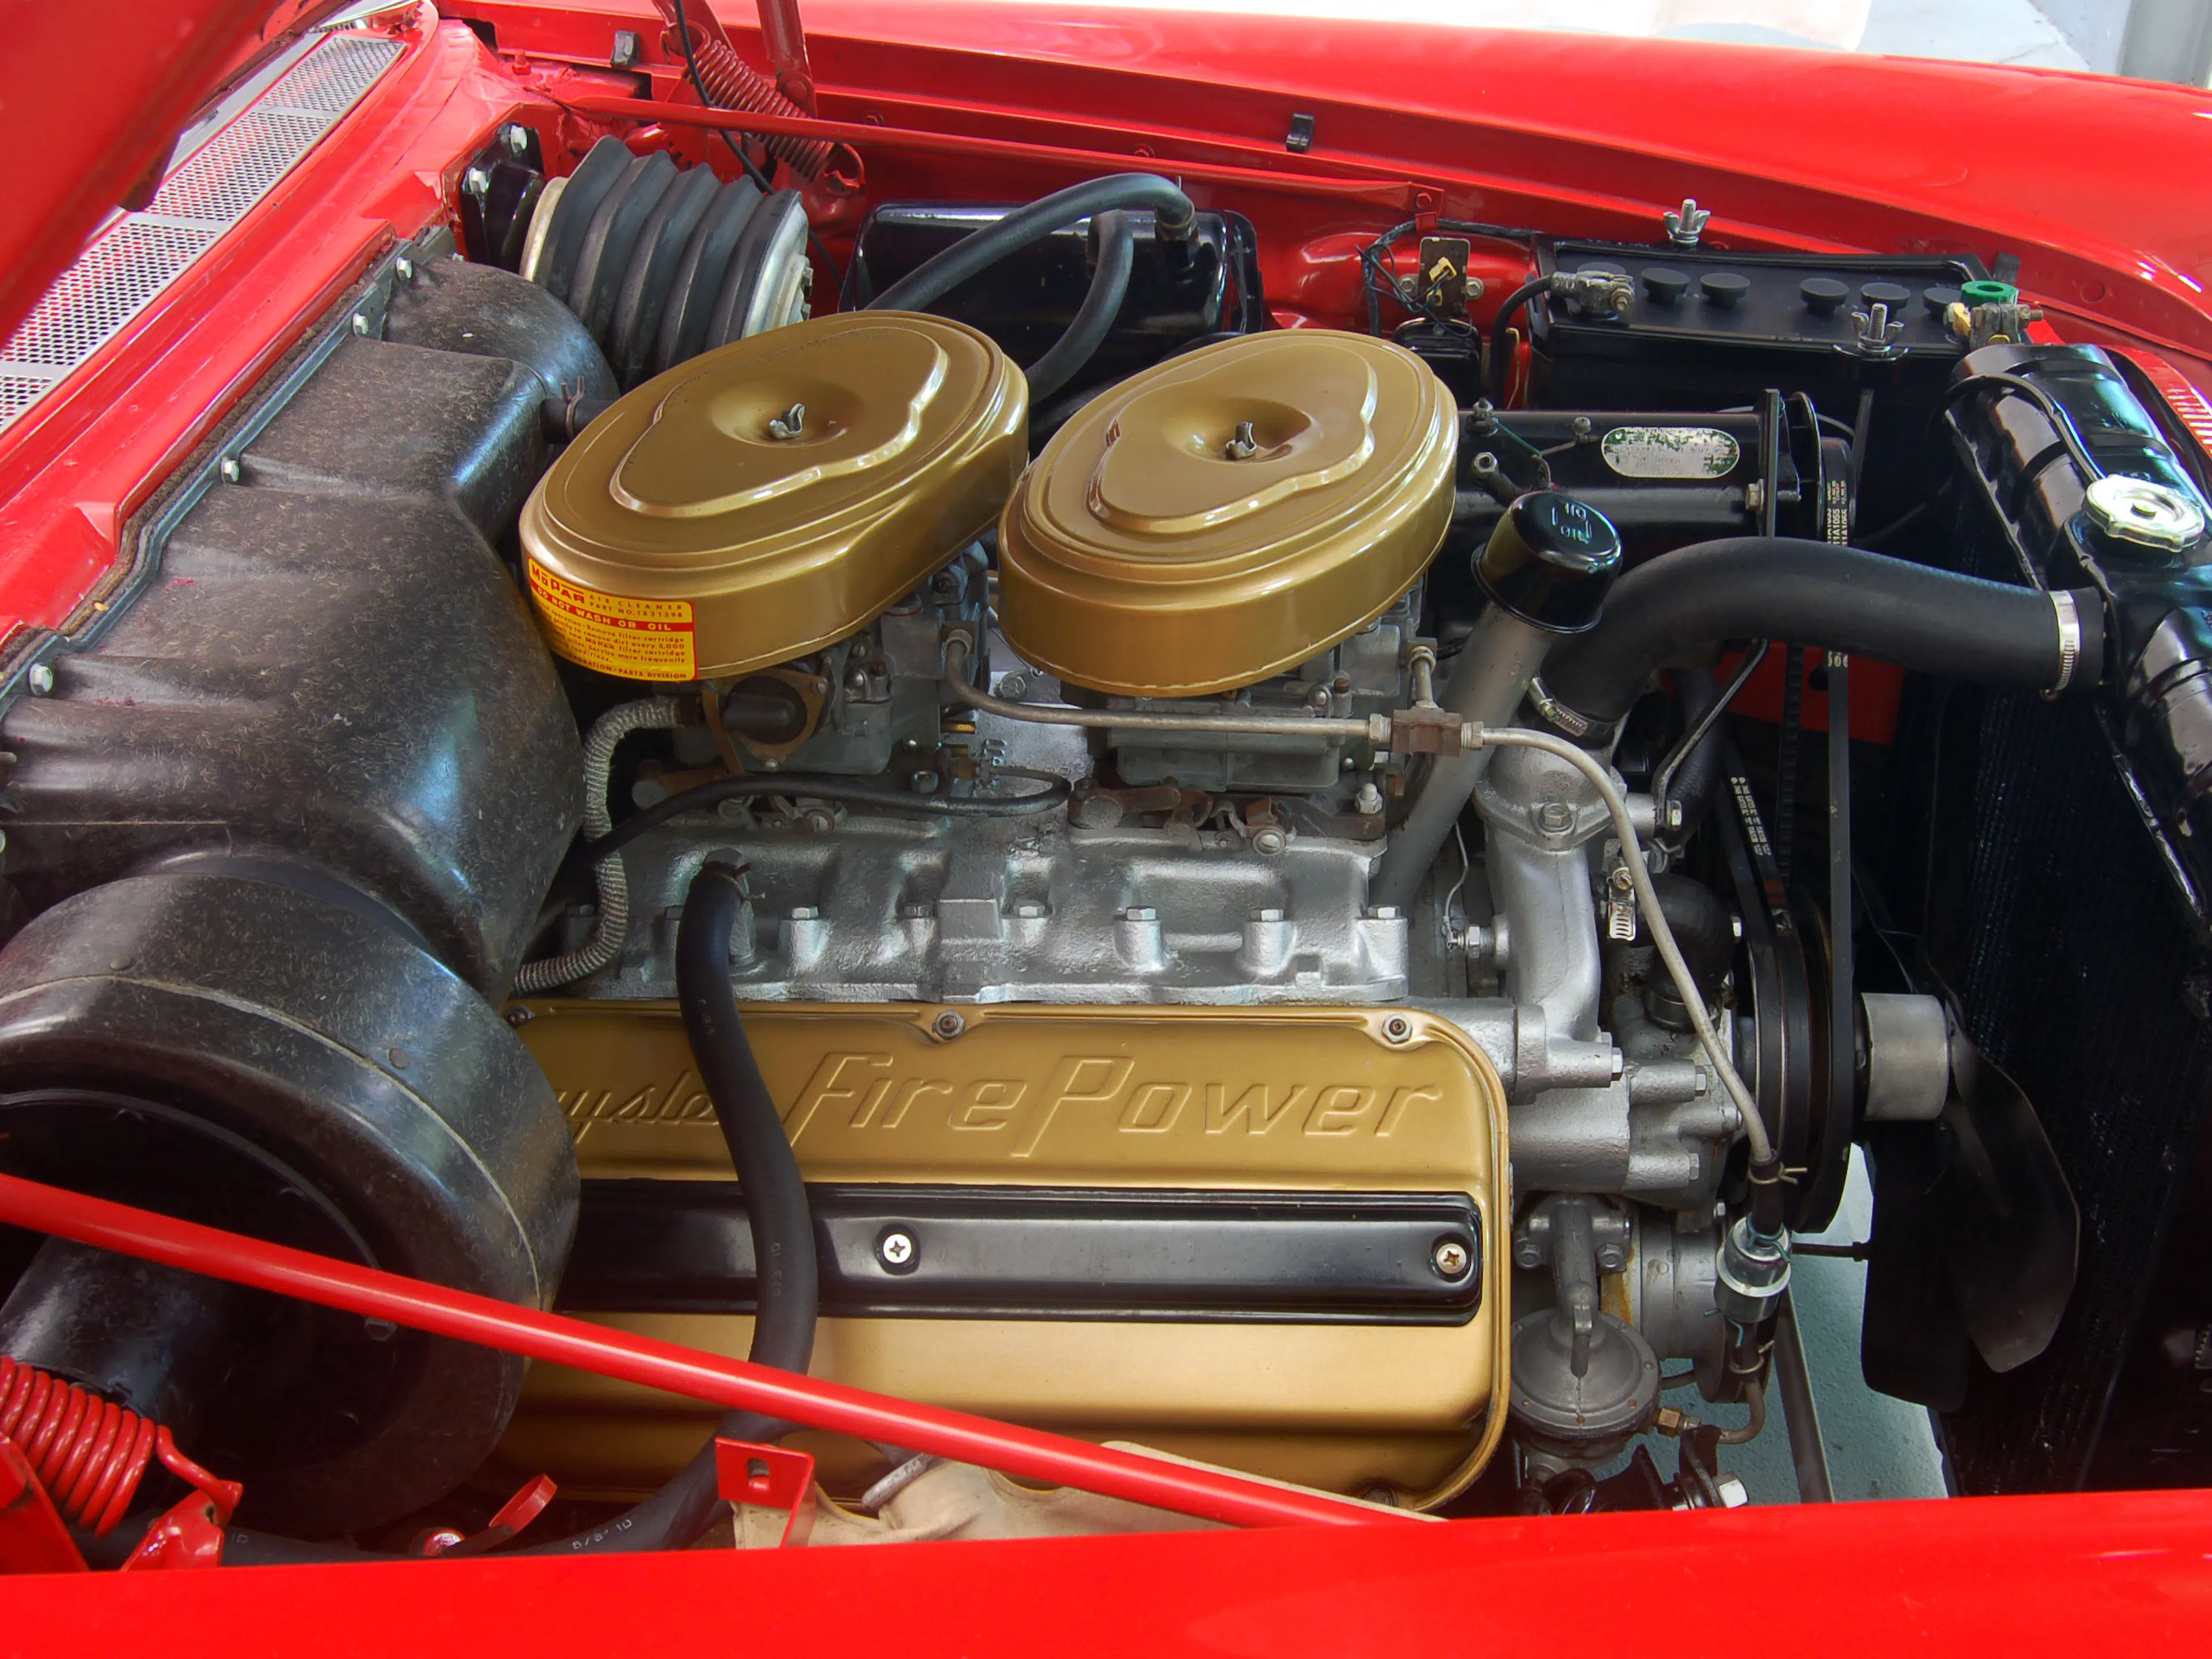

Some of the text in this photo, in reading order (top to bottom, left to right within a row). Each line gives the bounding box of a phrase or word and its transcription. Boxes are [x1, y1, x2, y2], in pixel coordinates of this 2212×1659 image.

[589, 594, 682, 610] AIR CLEANER
[590, 601, 612, 612] PART
[551, 597, 570, 611] NOT
[575, 608, 611, 624] WASH
[618, 619, 637, 629] OR
[647, 623, 671, 631] OIL
[619, 632, 641, 641] filter
[613, 638, 629, 646] dirt
[619, 646, 641, 654] filter
[641, 655, 685, 664] frequently
